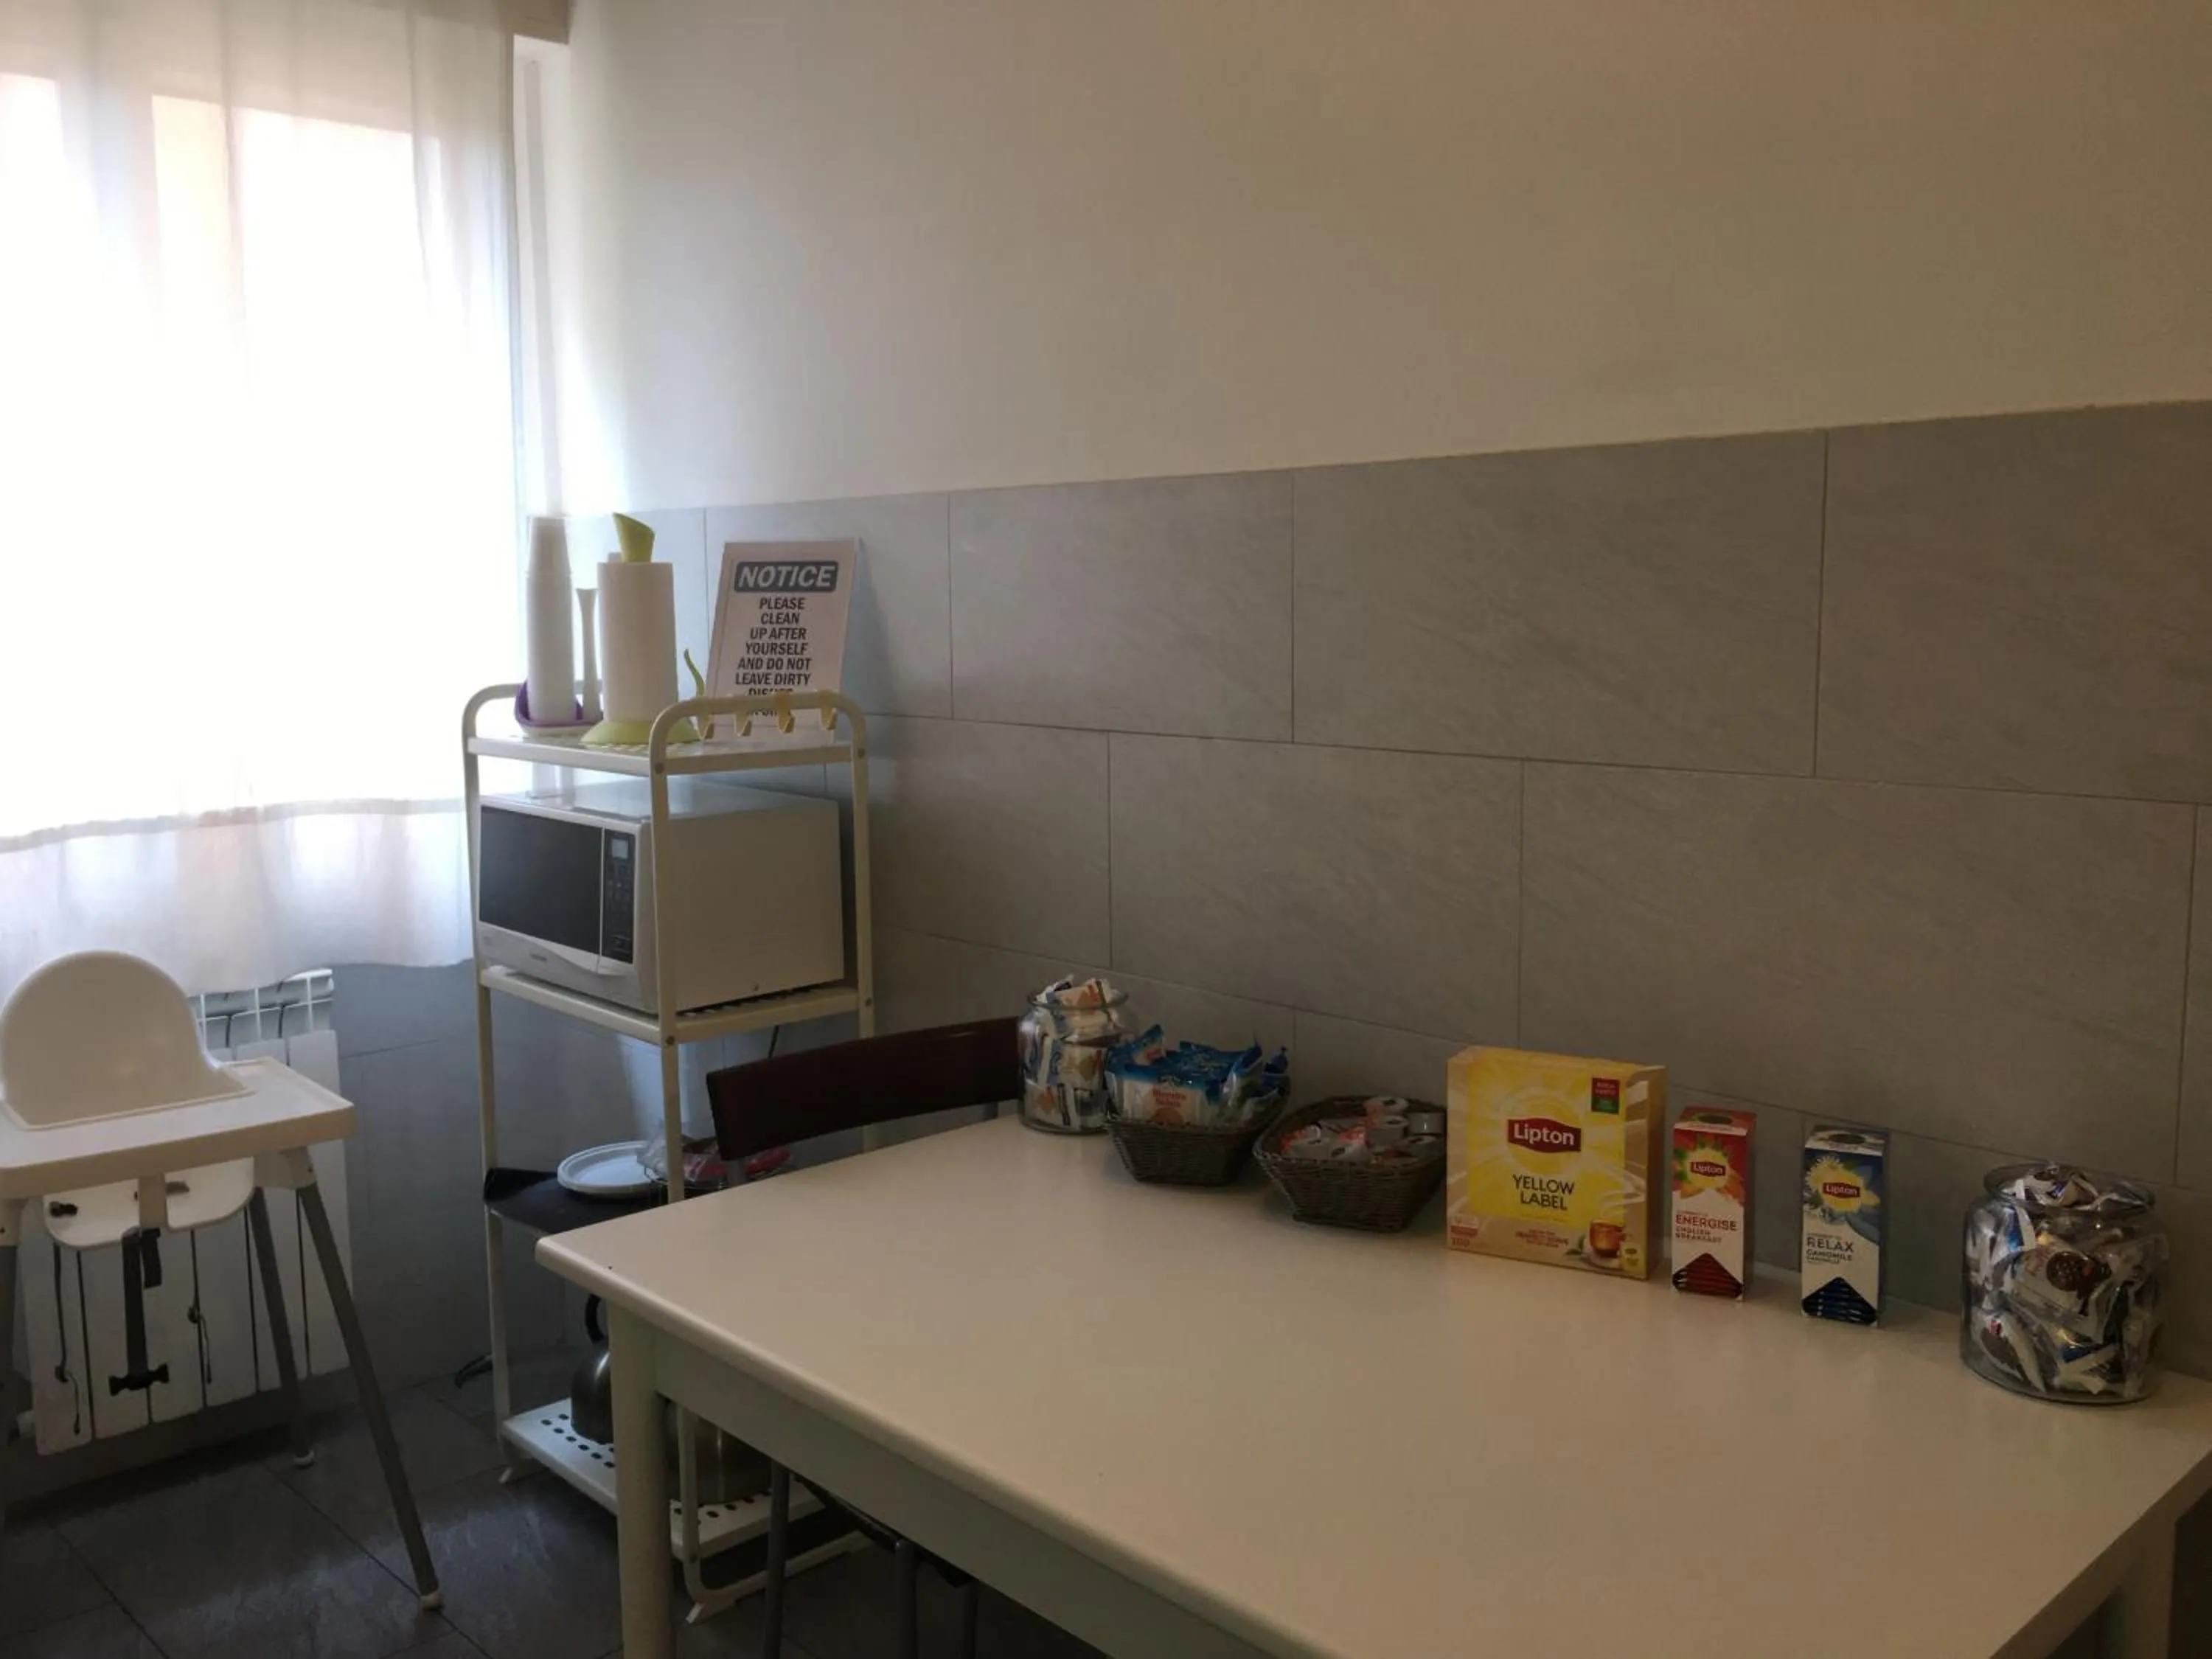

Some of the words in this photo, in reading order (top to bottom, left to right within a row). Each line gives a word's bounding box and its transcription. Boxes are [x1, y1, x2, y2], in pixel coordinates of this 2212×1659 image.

[738, 566, 835, 588] NOTICE
[759, 597, 805, 609] PLEASE
[761, 613, 800, 625] CLEAN
[750, 627, 767, 639] UP
[769, 627, 807, 639] AFTER
[745, 642, 808, 655] YOURSELF
[738, 657, 763, 669] AND
[766, 658, 785, 669] DO
[786, 658, 813, 669] NOT
[735, 672, 771, 685] LEAVE
[773, 672, 813, 685] DIRTY
[1513, 1123, 1575, 1145] Lipton
[1693, 1162, 1723, 1175] Lipton
[1512, 1174, 1575, 1195] YELLOW
[1825, 1184, 1858, 1197] Lipton
[1520, 1192, 1568, 1211] LABEL
[1675, 1214, 1737, 1231] ENERGISE
[1807, 1237, 1854, 1253] RELAX
